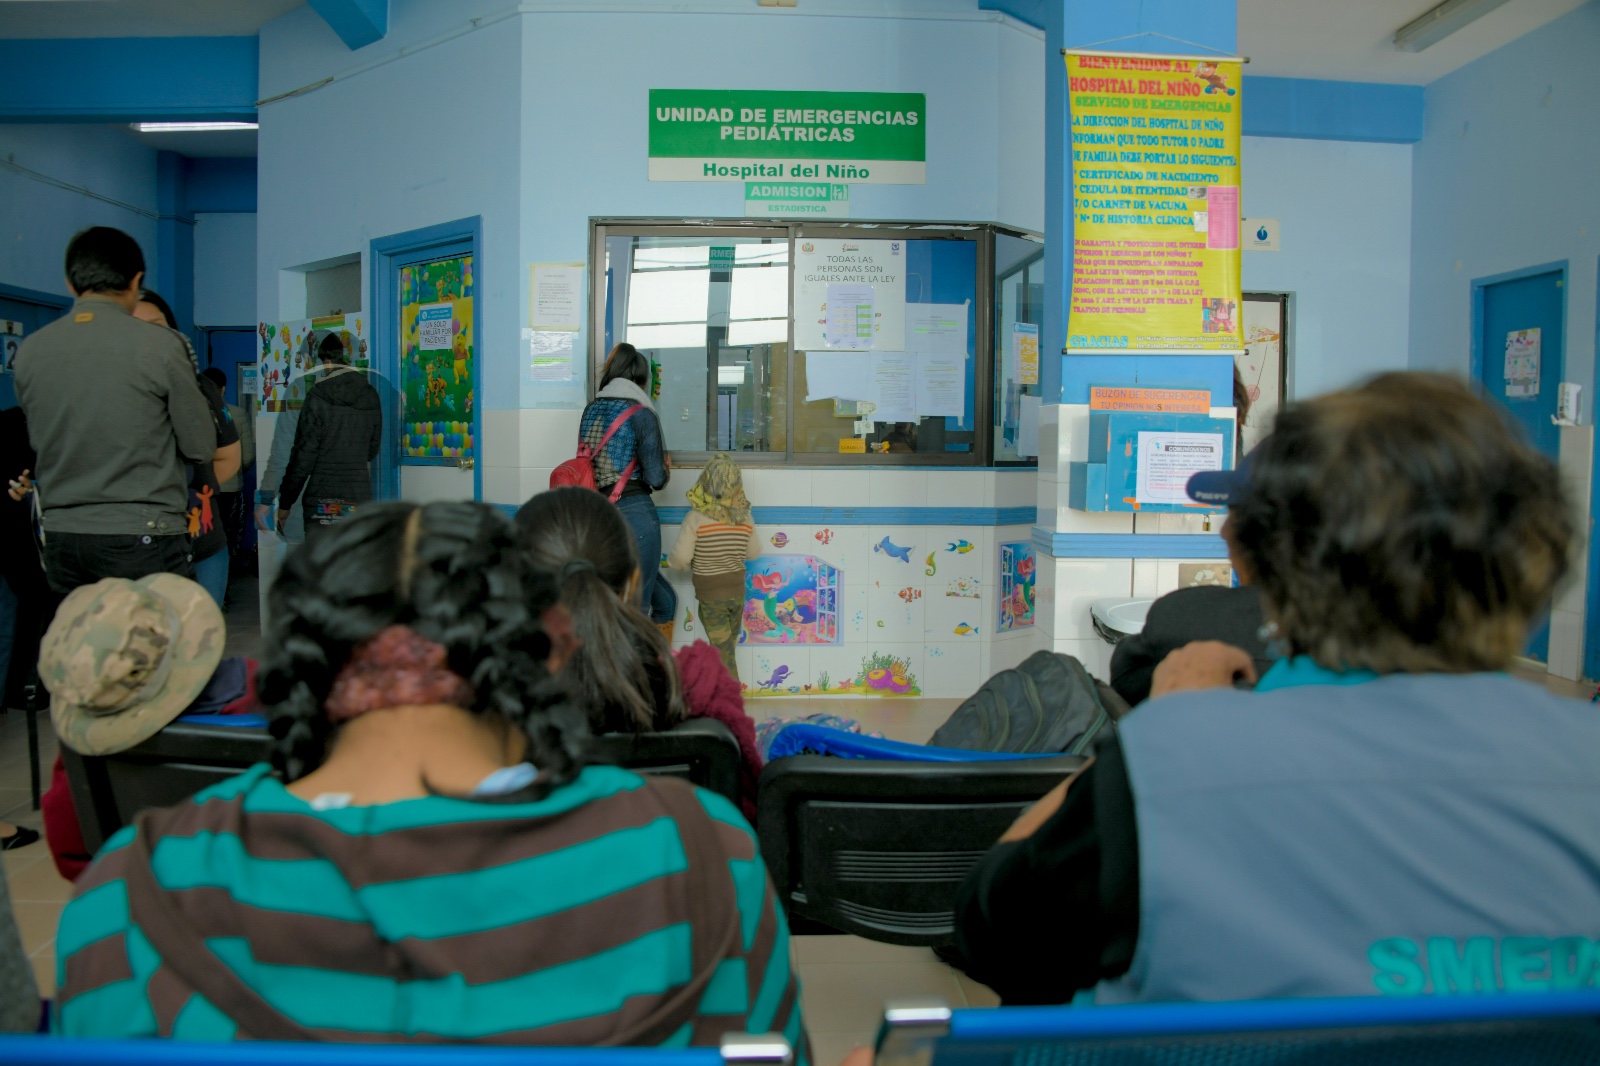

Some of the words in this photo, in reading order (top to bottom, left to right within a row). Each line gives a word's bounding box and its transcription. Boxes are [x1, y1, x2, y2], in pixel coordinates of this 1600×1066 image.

[1078, 55, 1171, 72] BIENVENIDOS
[1174, 60, 1192, 73] AL
[1070, 76, 1136, 94] HOSPITAL
[1138, 79, 1164, 95] DEL
[1167, 78, 1201, 97] NIÑO
[1076, 96, 1130, 108] SERVICIO
[1132, 98, 1148, 109] DE
[1151, 99, 1232, 113] EMERGENCIAS
[656, 107, 734, 123] UNIDAD
[740, 108, 767, 123] DE
[773, 109, 919, 126] EMERGENCIAS
[1083, 115, 1129, 127] DIRECCION
[1132, 117, 1147, 128] DEL
[1149, 117, 1189, 130] HOSPITAL
[1191, 119, 1202, 130] DE
[1204, 117, 1225, 131] NIÑO
[720, 123, 856, 142] PEDIÁTRICAS
[1073, 133, 1115, 145] NFORMAN
[1117, 134, 1135, 147] QUE
[1136, 135, 1159, 146] TODO
[1161, 135, 1189, 148] TUTOR
[1190, 136, 1197, 148] O
[1199, 137, 1225, 149] PADRE
[1083, 151, 1119, 162] FAMILIA
[1120, 152, 1142, 163] DEBE
[1144, 152, 1177, 164] PORTAR
[1178, 154, 1189, 165] LO
[703, 163, 784, 180] Hospital
[790, 164, 819, 178] del
[826, 164, 870, 179] Niño
[1079, 169, 1144, 180] CERTIFICADO
[1146, 171, 1158, 181] DE
[1160, 172, 1219, 183] NACIMIENTO
[750, 185, 827, 198] ADMISION
[1079, 184, 1119, 195] CEDULA
[1121, 185, 1134, 195] DE
[1135, 186, 1188, 197] ITENTIDAD
[768, 204, 827, 213] ESTADISTICA
[1091, 199, 1131, 209] CARNET
[1133, 200, 1146, 210] DE
[1148, 200, 1188, 211] VACUNA
[1092, 214, 1105, 224] DE
[1107, 214, 1154, 225] HISTORIA
[1155, 215, 1195, 226] CLINICA
[1081, 239, 1116, 247] GARANTIA
[826, 255, 856, 263] TODAS
[1166, 249, 1187, 258] NIÑOS
[816, 265, 863, 273] PERSONAS
[864, 265, 883, 273] SON
[1093, 259, 1107, 267] QUE
[1117, 259, 1162, 267] ENCUENTRAN
[1163, 260, 1204, 268] AMPARADOS
[804, 274, 841, 282] IGUALES
[842, 275, 866, 283] ANTE
[868, 275, 879, 283] LA
[880, 275, 896, 283] LEY
[1069, 335, 1129, 348] GRACIAS
[6, 340, 18, 370] 2
[1095, 387, 1127, 399] BUZON
[1129, 389, 1142, 399] DE
[1143, 390, 1208, 402] SUGERENCIAS
[1100, 401, 1111, 410] TU
[1112, 402, 1145, 412] OPINION
[1146, 403, 1163, 412] NOS
[1164, 404, 1203, 413] INTERESA
